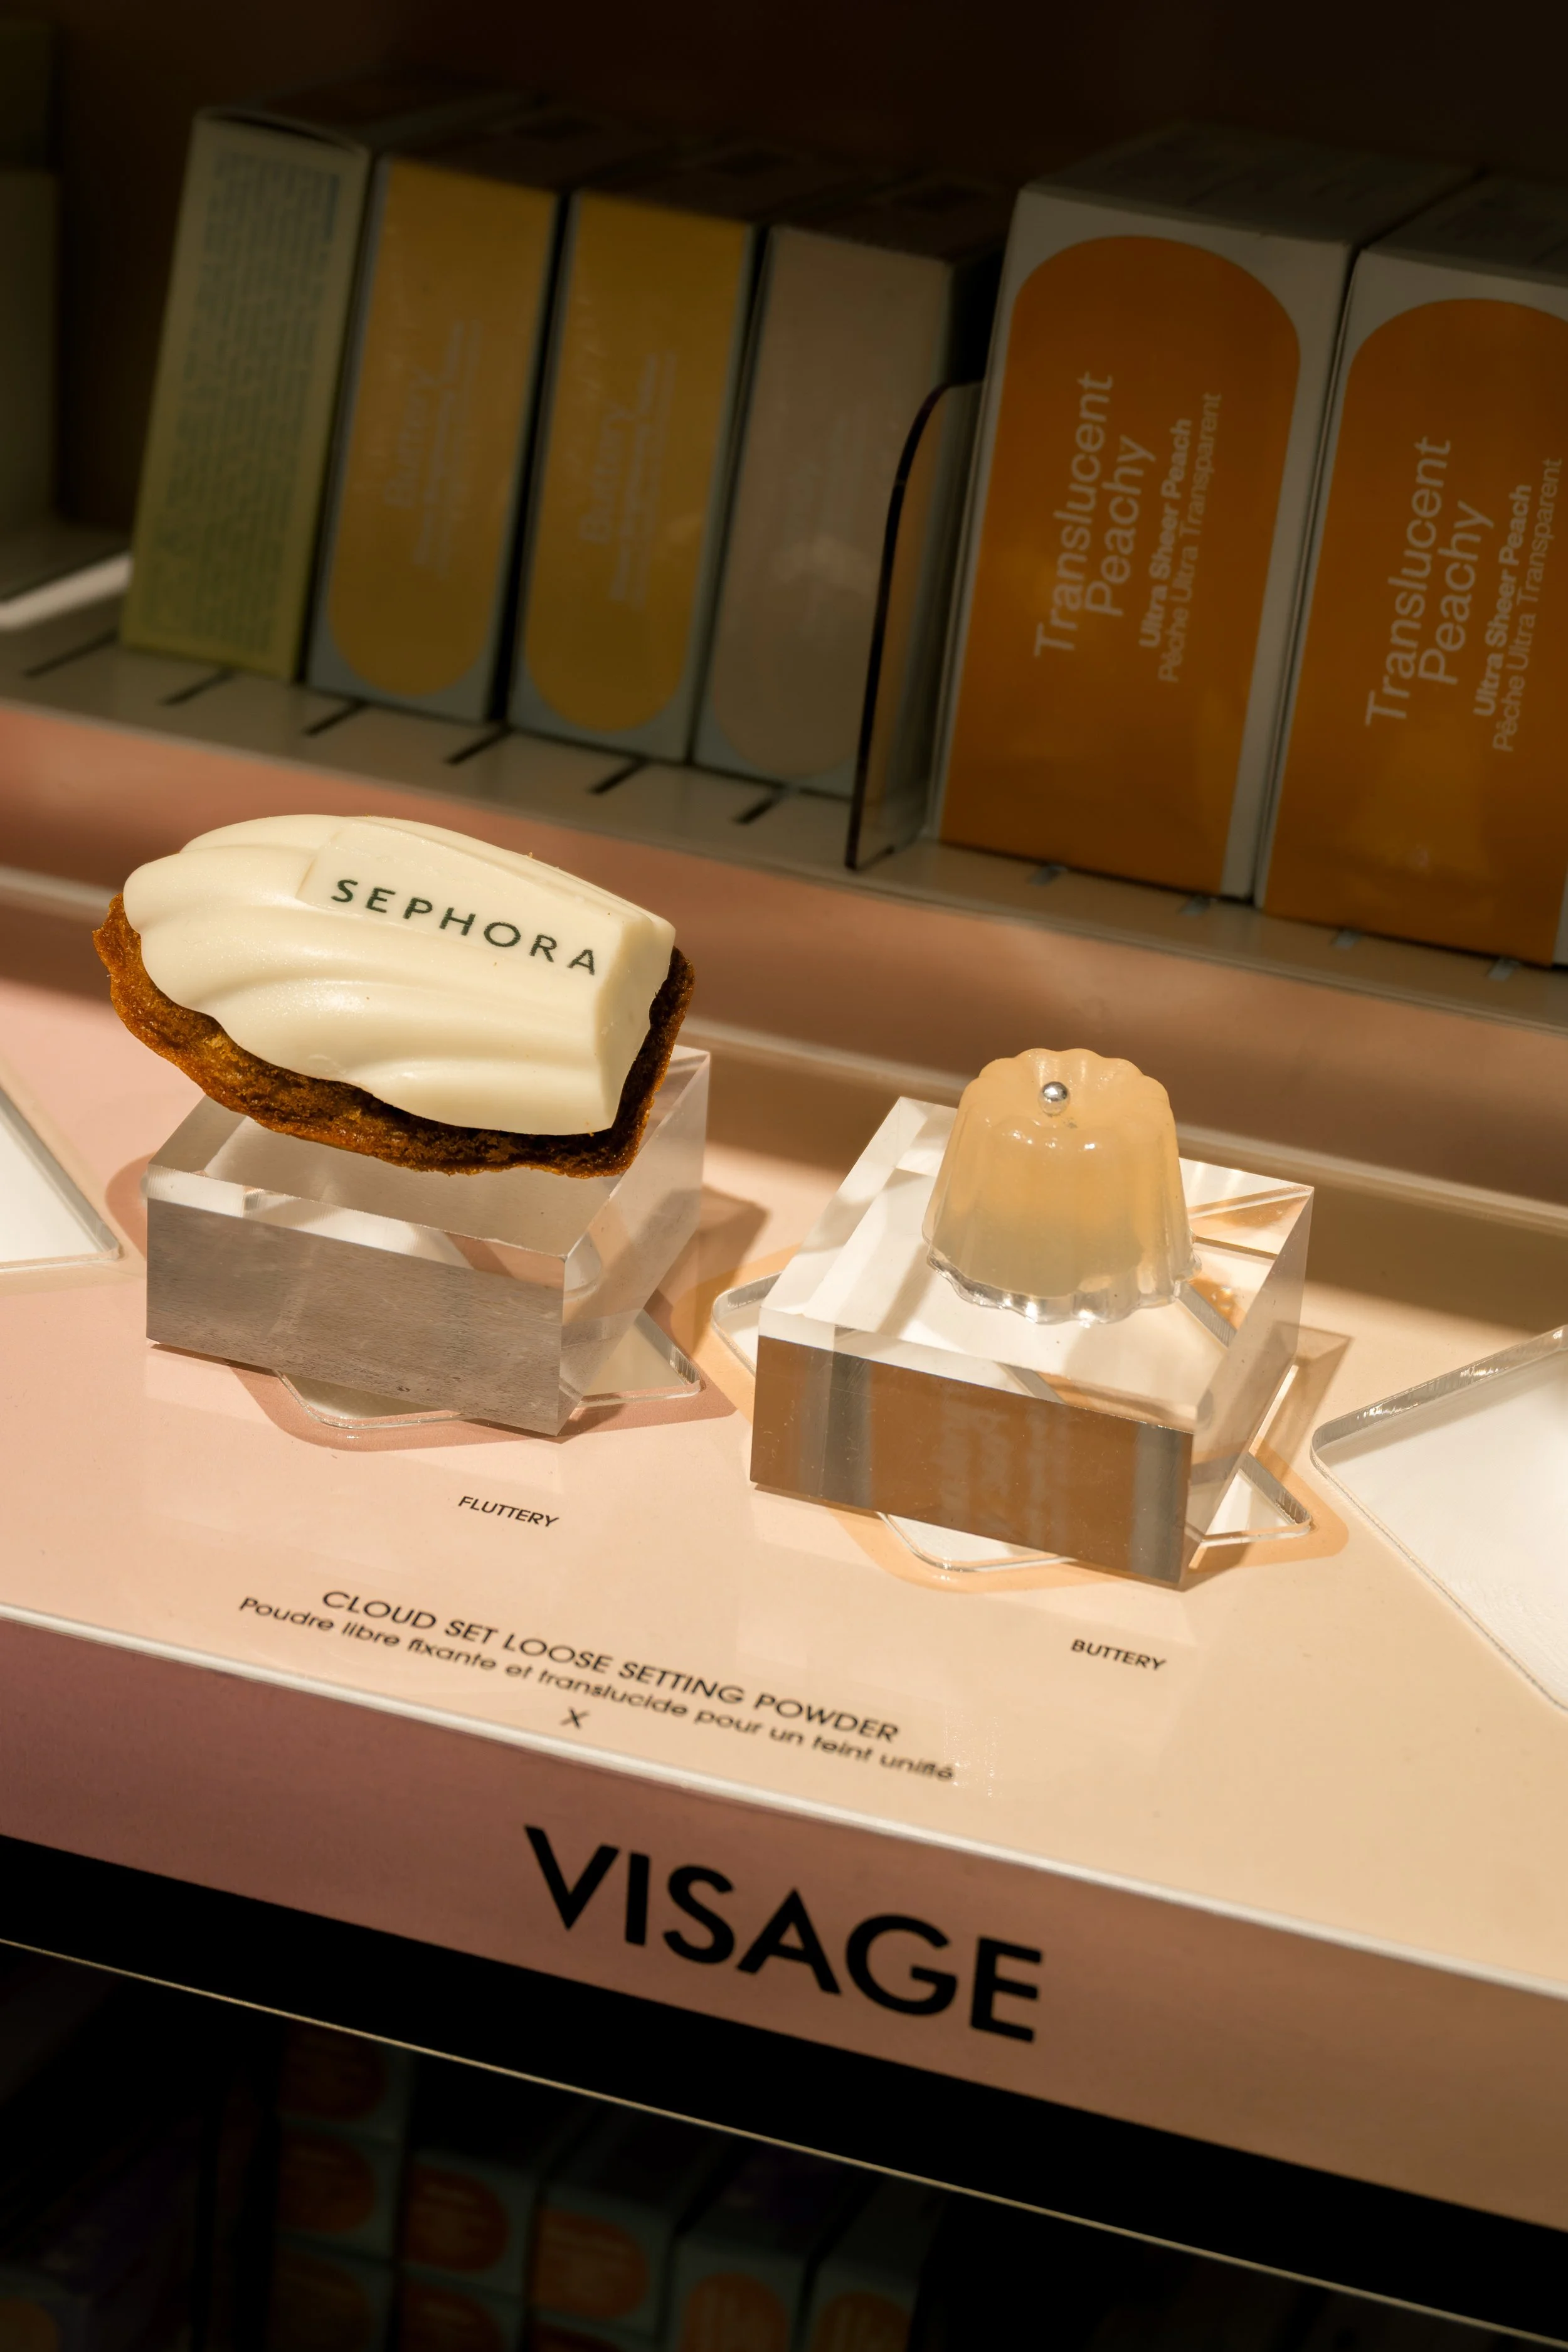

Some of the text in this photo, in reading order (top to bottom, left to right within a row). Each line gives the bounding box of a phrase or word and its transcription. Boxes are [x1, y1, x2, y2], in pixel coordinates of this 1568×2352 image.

[1033, 371, 1114, 658] Translucent
[1083, 435, 1157, 617] Peachy
[1138, 418, 1192, 649] Ultra Sheer Peach
[1157, 391, 1222, 683] Pêche Ultra Transparent
[1364, 436, 1451, 727] Translucent
[1417, 500, 1495, 686] Peachy
[1472, 484, 1532, 717] Ultra Sheer Peach
[1491, 457, 1562, 753] Pêche Ultra Transparent
[331, 879, 595, 976] SEPHORA
[457, 1495, 559, 1528] FLUTTERY
[239, 1596, 335, 1631] Poudre
[341, 1621, 401, 1647] libre
[407, 1638, 497, 1670] fixante
[505, 1665, 533, 1679] et
[538, 1669, 689, 1717] translucide
[694, 1710, 763, 1734] pour
[769, 1727, 805, 1745] un
[812, 1735, 874, 1762] teint
[322, 1591, 899, 1744] CLOUD SET LOOSE SETTING POWDER
[1070, 1638, 1167, 1671] BUTTERY
[524, 1825, 1043, 2043] VISAGE
